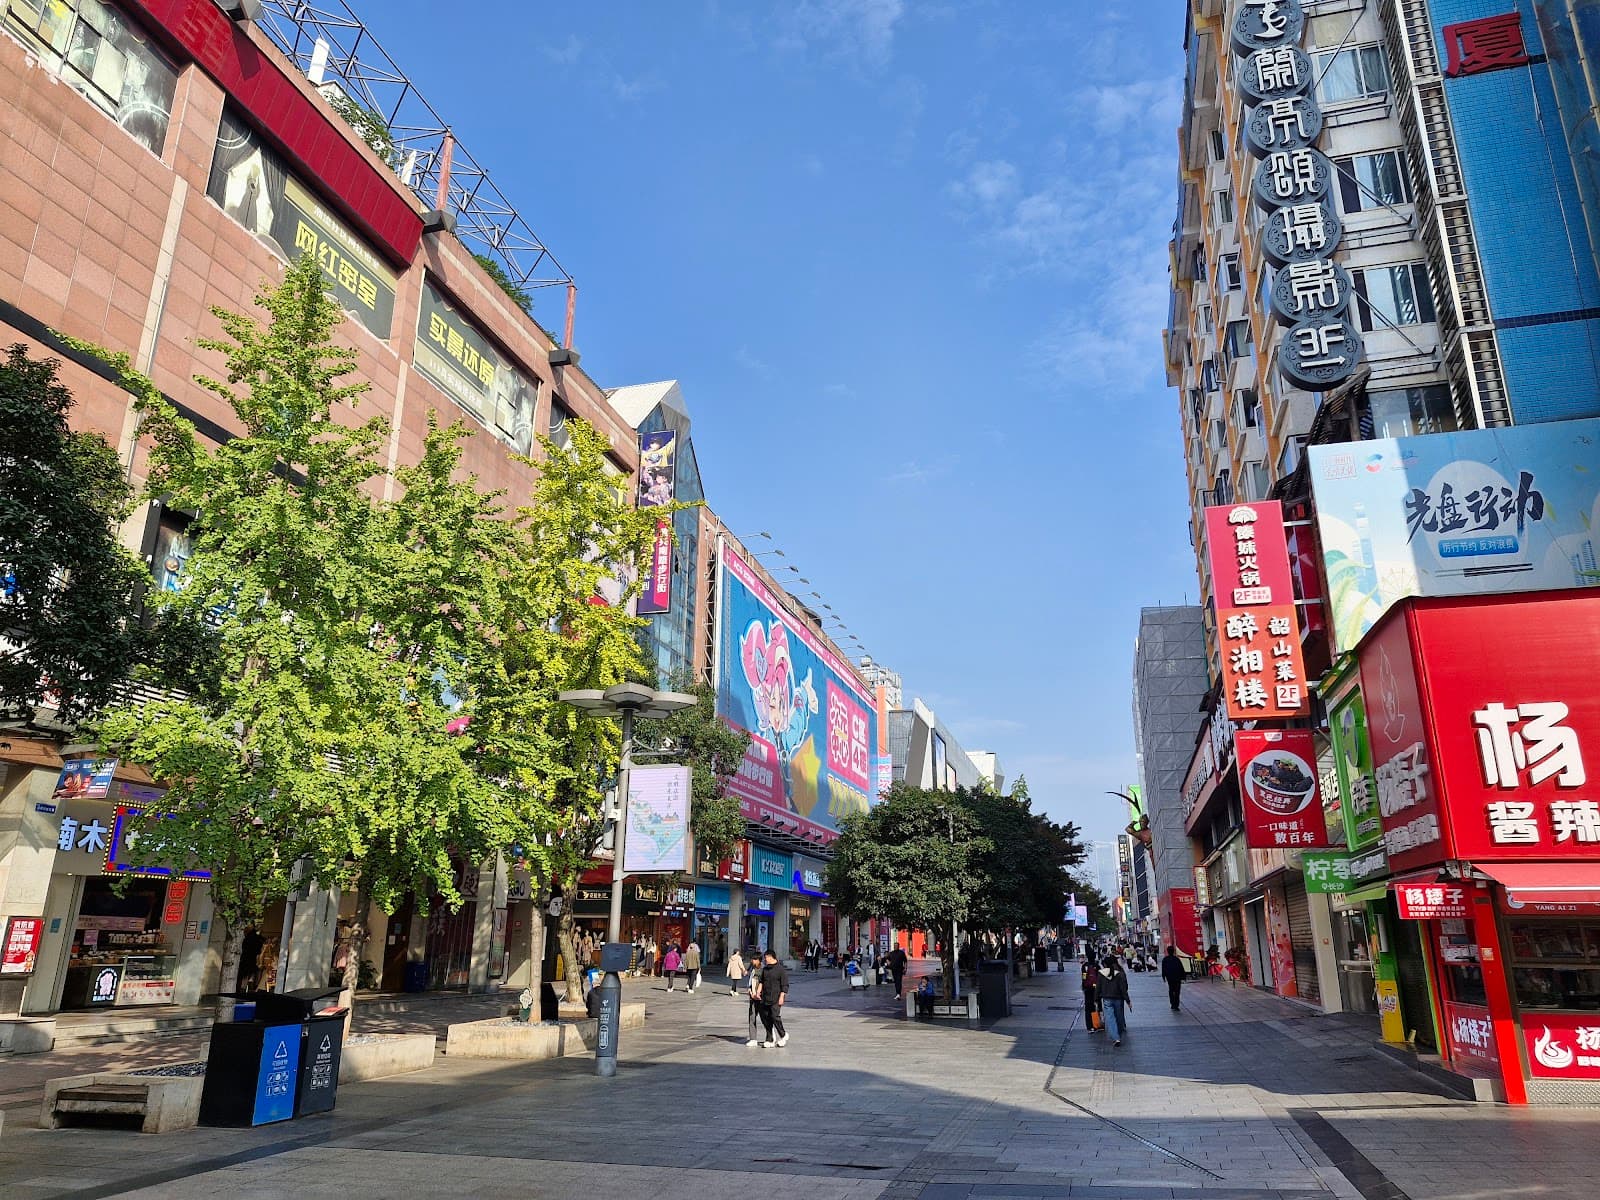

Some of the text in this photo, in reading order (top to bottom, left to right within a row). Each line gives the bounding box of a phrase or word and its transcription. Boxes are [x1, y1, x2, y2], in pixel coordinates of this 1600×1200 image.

[295, 219, 378, 311] 网红密室
[429, 311, 495, 386] 实景还原
[1296, 323, 1345, 357] 3F
[1406, 471, 1545, 545] 光盘行动
[1236, 591, 1250, 601] 2F
[1226, 613, 1268, 708] 醉湘楼
[1269, 616, 1297, 682] 韶山菜
[1280, 687, 1297, 699] 2F
[1474, 701, 1586, 787] 杨
[1258, 821, 1298, 831] 一口味道
[1274, 832, 1315, 844] 数百年
[1306, 859, 1351, 880] 柠季
[1405, 888, 1464, 904] 杨矮子
